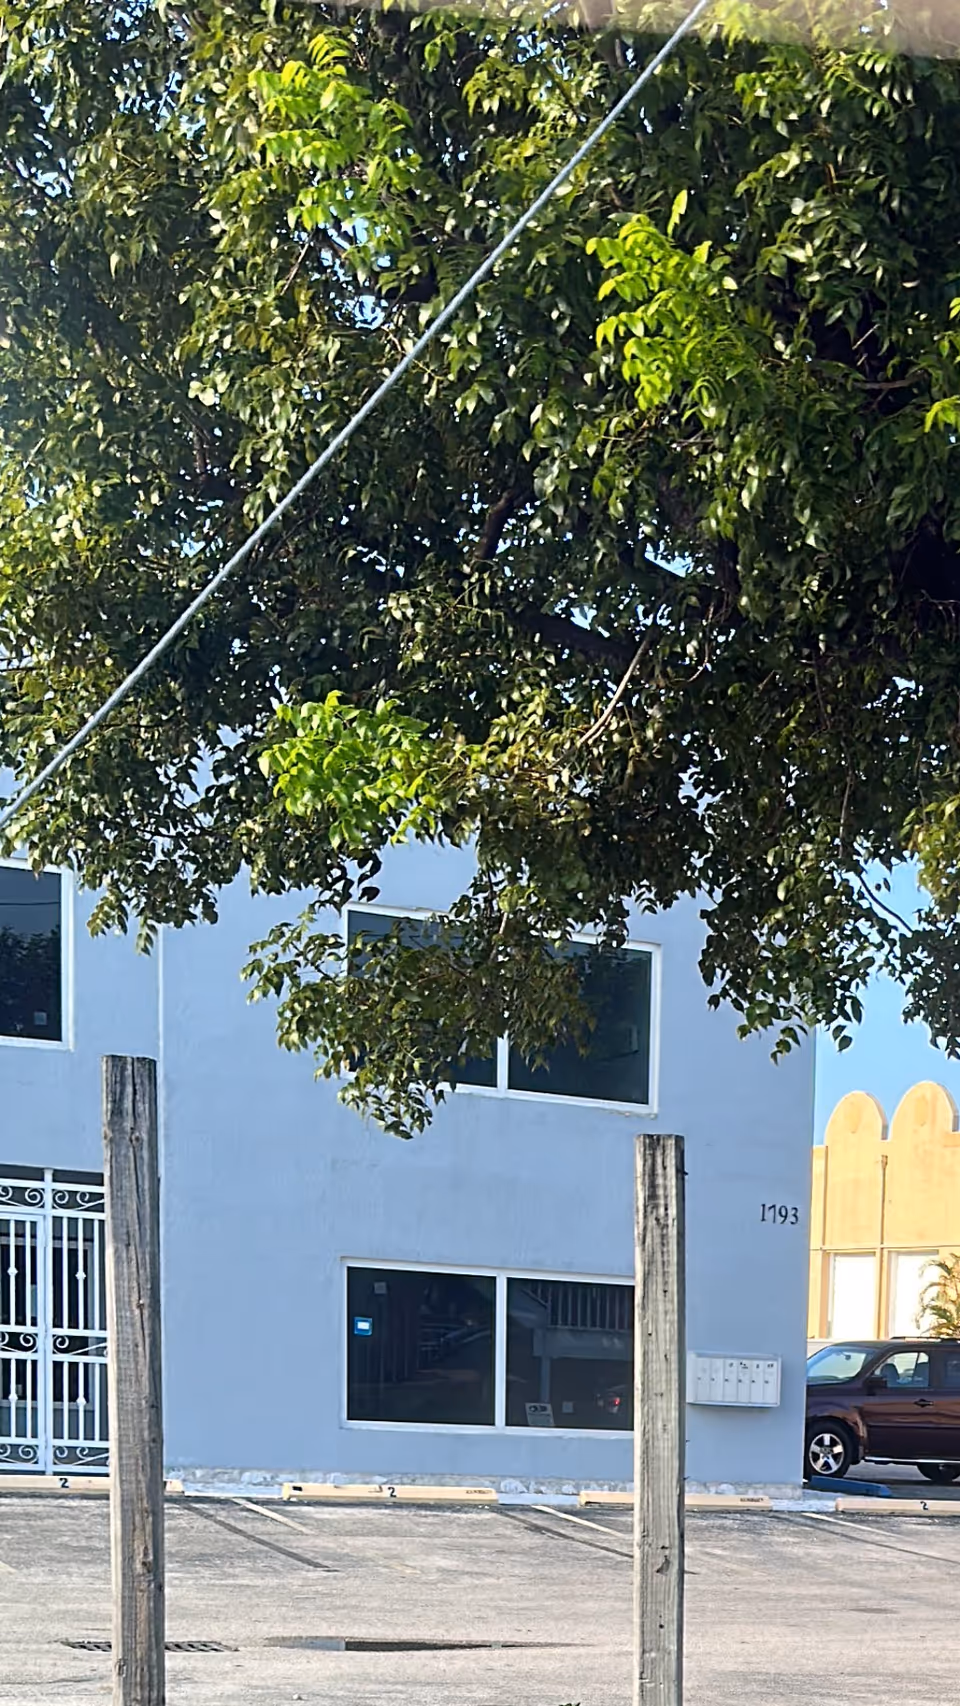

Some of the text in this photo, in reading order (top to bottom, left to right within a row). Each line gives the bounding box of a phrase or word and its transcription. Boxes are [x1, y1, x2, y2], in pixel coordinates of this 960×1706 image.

[761, 1203, 799, 1225] 1793
[59, 1477, 69, 1488] 2
[387, 1486, 397, 1498] 2
[920, 1500, 929, 1511] 2
